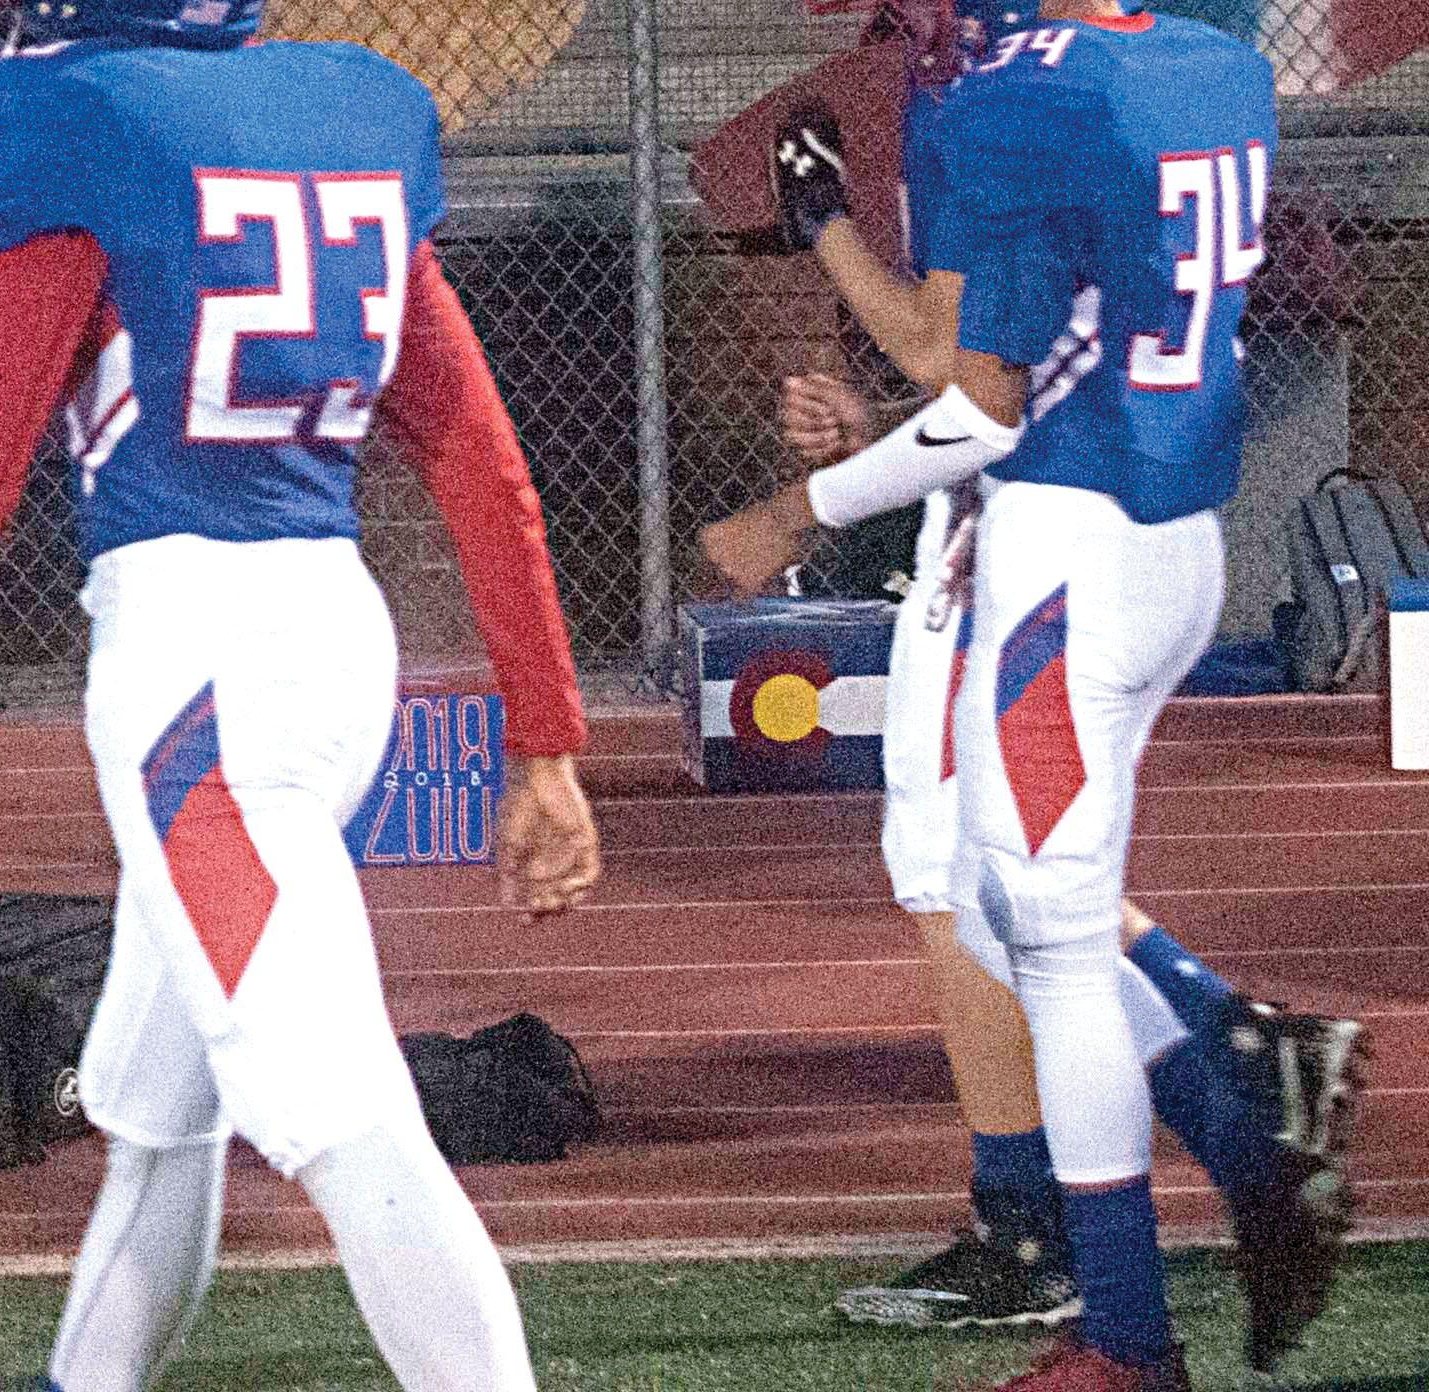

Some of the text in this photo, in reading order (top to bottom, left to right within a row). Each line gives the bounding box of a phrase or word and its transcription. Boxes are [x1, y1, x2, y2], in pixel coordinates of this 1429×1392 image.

[979, 28, 1078, 72] 34
[185, 168, 407, 445] 23
[1128, 140, 1267, 393] 34
